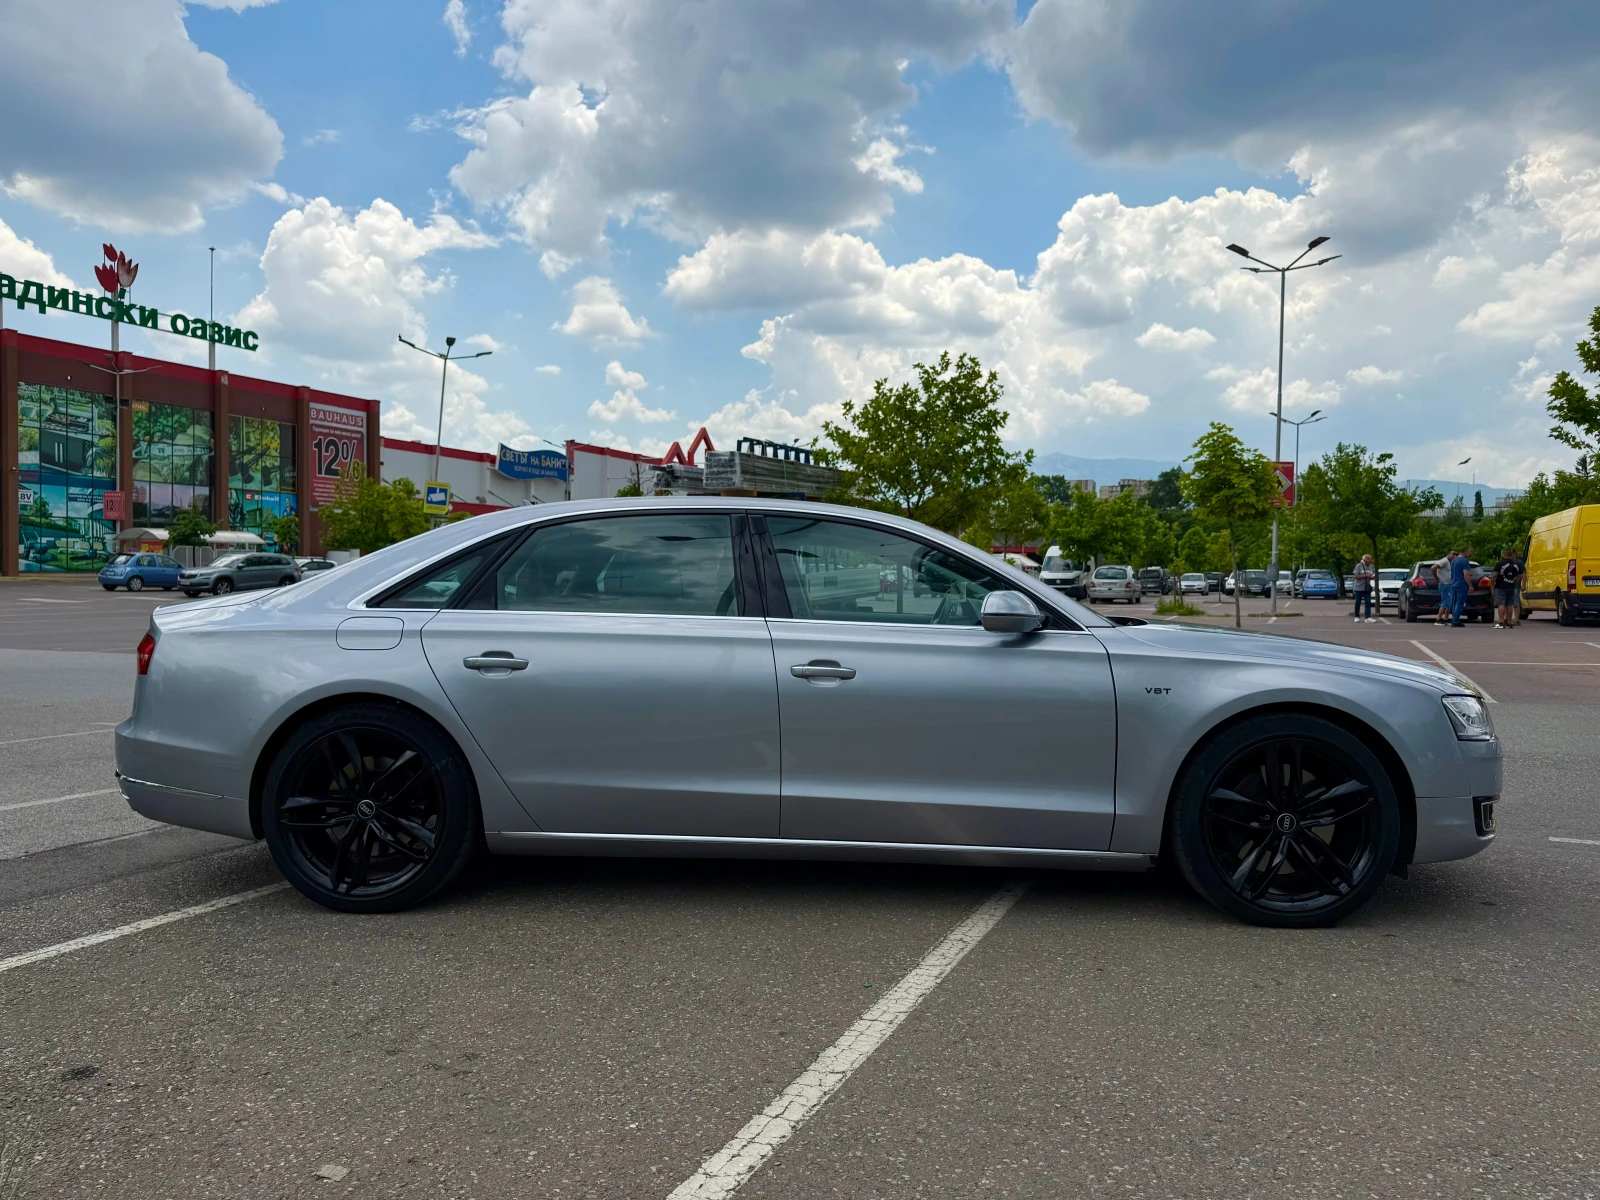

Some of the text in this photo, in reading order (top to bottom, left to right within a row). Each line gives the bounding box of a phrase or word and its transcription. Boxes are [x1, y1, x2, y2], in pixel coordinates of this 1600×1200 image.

[170, 313, 259, 351] оазис
[311, 409, 363, 426] BAUHAUS
[312, 436, 361, 481] 12%
[500, 448, 529, 464] СВЕТЪТ
[530, 455, 540, 466] НА
[1145, 687, 1171, 695] V8T
